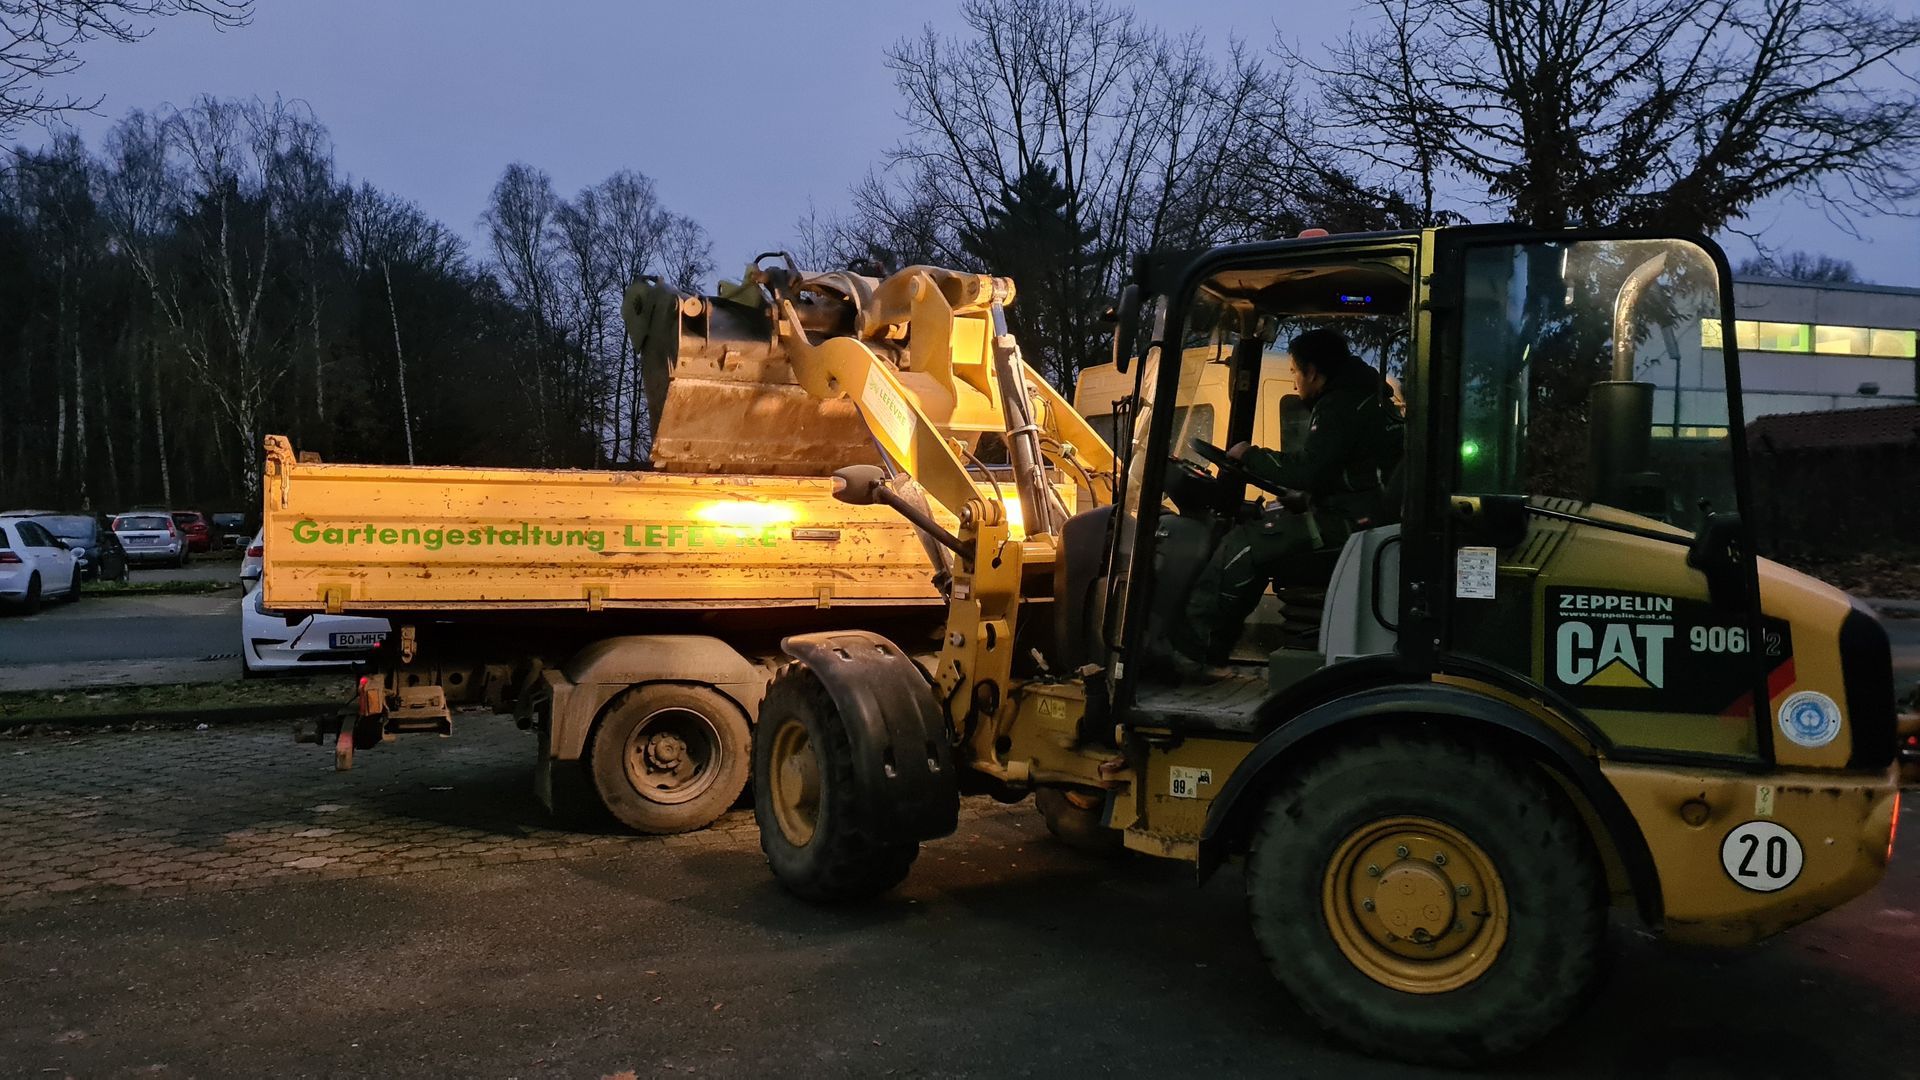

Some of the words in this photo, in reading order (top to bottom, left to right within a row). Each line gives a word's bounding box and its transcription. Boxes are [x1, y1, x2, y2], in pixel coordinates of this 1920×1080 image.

[293, 520, 605, 551] Gartengestaltung
[1559, 594, 1673, 611] ZEPPELIN
[1559, 611, 1673, 620] www.zeppelin-cat.de
[340, 634, 355, 645] BO
[1556, 621, 1674, 689] CAT
[1738, 833, 1788, 879] 20
